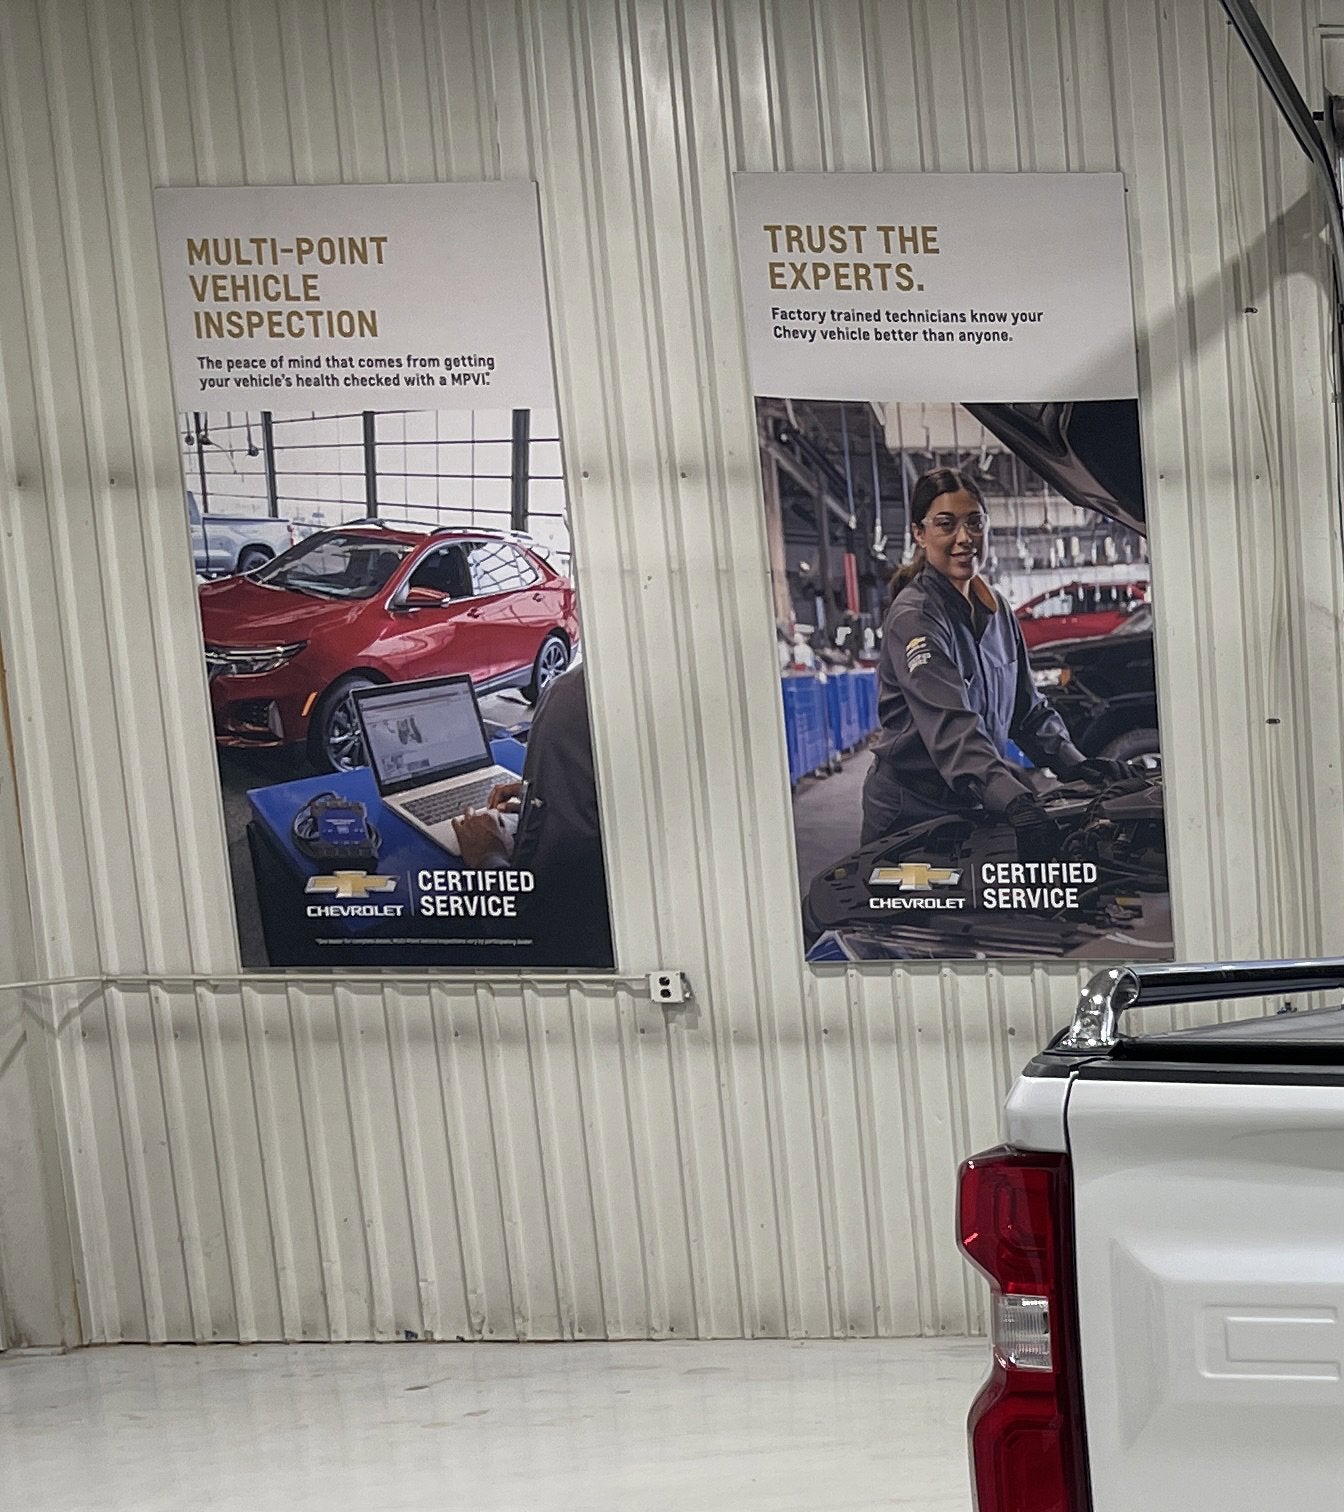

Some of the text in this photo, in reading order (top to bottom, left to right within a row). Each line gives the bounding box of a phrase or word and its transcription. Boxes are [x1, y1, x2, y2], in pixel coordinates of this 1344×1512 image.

[763, 224, 940, 254] TRUST THE
[186, 236, 388, 266] MULTI-POINT
[189, 273, 320, 302] VEHICLE
[769, 262, 925, 292] EXPERTS.
[194, 310, 378, 338] INSPECTION
[771, 307, 1043, 325] Factory trained technicians know your
[773, 325, 1013, 344] Chevy vehicle better than anyone.
[197, 354, 495, 372] The peace of mind that comes from getting
[199, 376, 229, 390] your
[296, 374, 339, 387] health
[343, 373, 400, 387] checked
[404, 373, 434, 387] with
[439, 376, 447, 386] a
[418, 870, 534, 892] CERTIFIED
[981, 862, 1097, 884] CERTIFIED
[420, 896, 517, 917] SERVICE
[869, 897, 965, 909] CHEVROLET
[983, 888, 1079, 908] SERVICE
[306, 904, 404, 917] CHEVROLET
